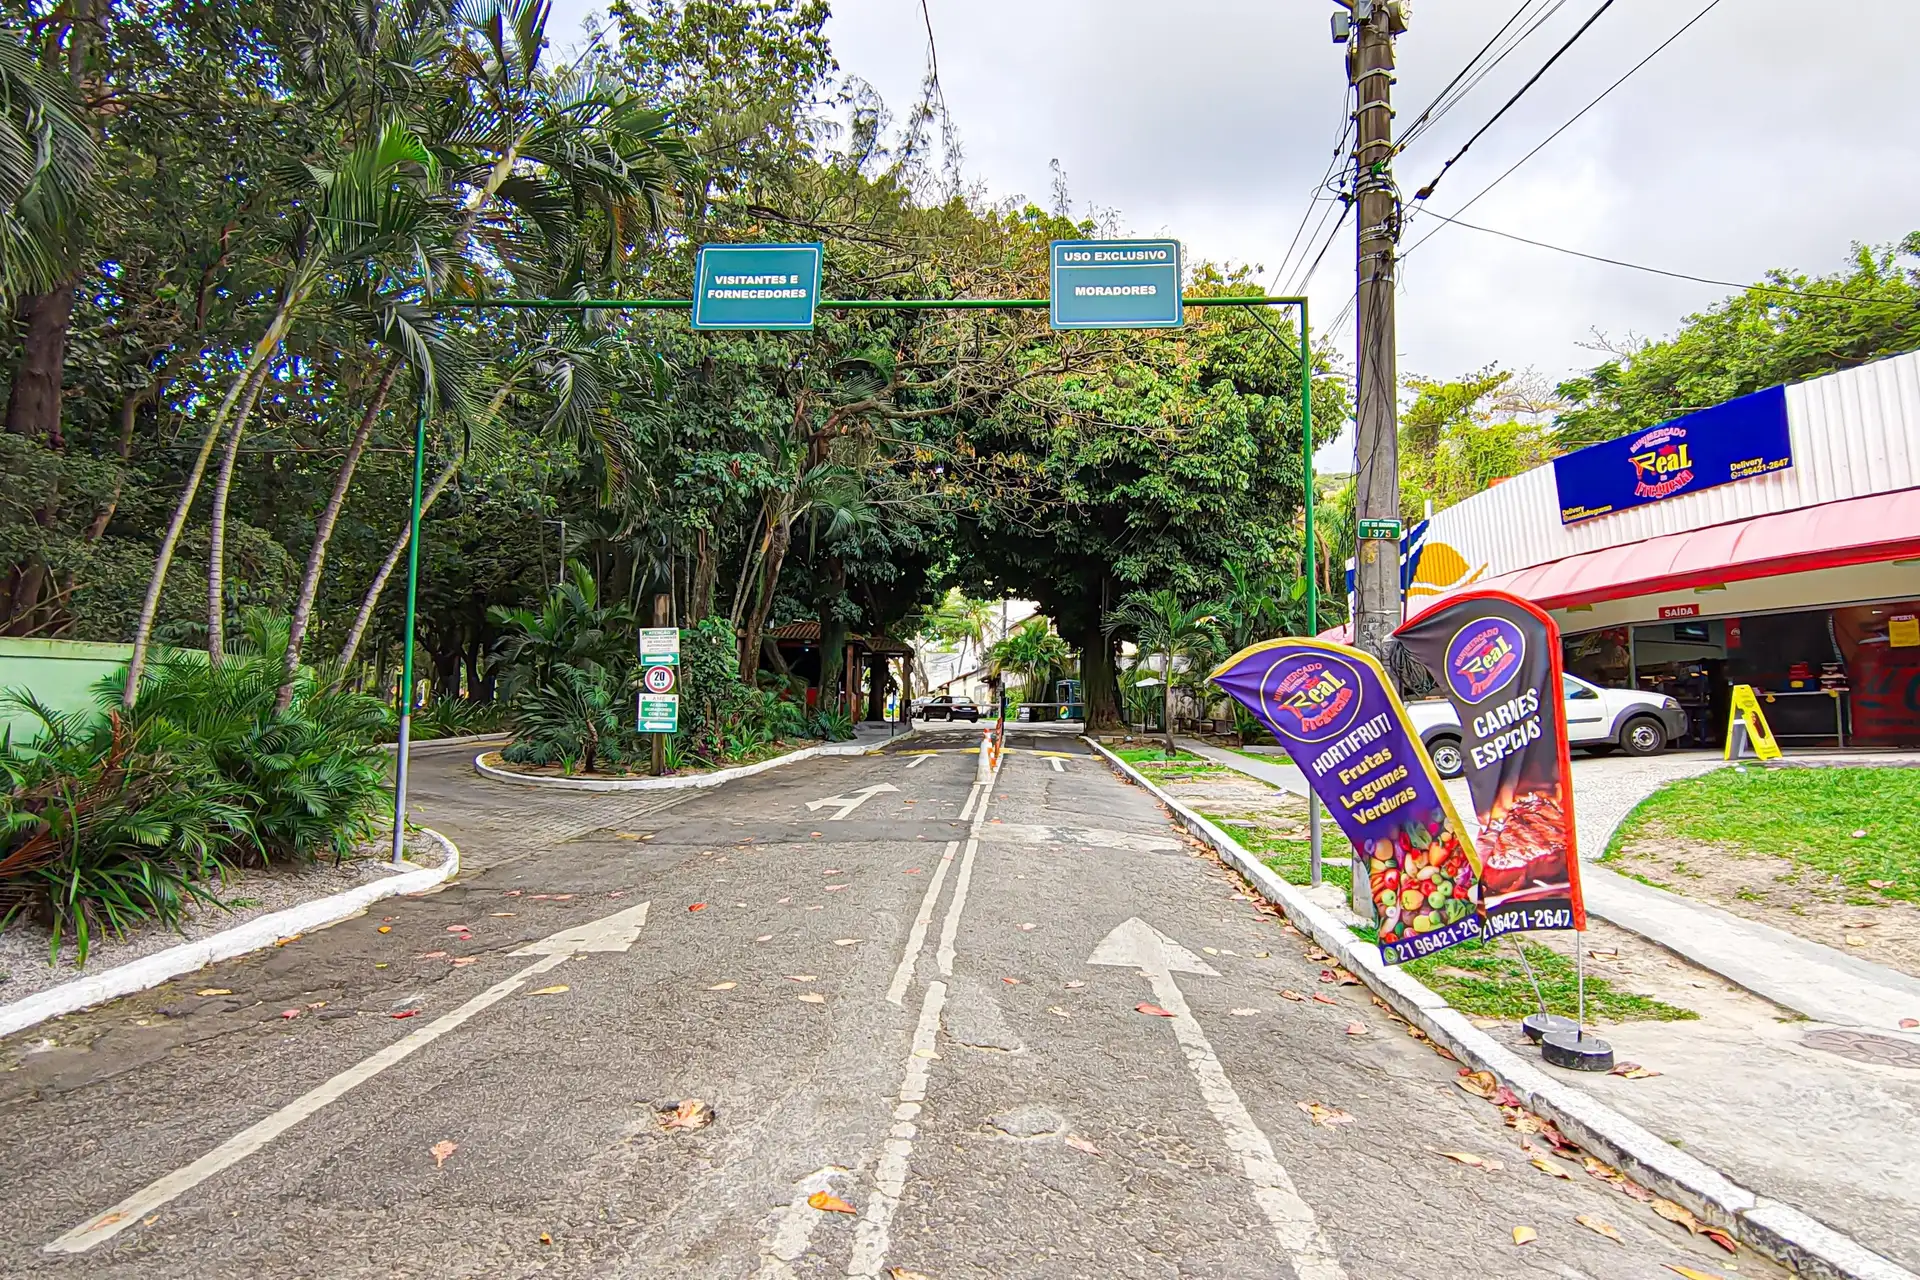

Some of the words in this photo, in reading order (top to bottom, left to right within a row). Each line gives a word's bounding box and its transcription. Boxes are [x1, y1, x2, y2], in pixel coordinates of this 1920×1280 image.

[1063, 251, 1091, 261] USO
[1094, 250, 1167, 261] EXCLUSIVO
[714, 275, 787, 285] VISITANTES
[790, 275, 799, 284] E
[707, 289, 807, 299] FORNECEDORES
[1075, 285, 1157, 296] MORADORES
[1730, 457, 1763, 471] Delivery
[1367, 528, 1392, 538] 1375
[1664, 606, 1694, 617] SAÍDA
[654, 671, 666, 681] 20
[1473, 688, 1539, 739] CARNES
[1311, 712, 1393, 778] HORTIFRUTI
[1338, 747, 1393, 786] Frutas
[1340, 764, 1409, 809] Legumes
[1351, 786, 1417, 825] Verduras
[1396, 943, 1416, 961] 21
[1416, 918, 1481, 956] 96421-26
